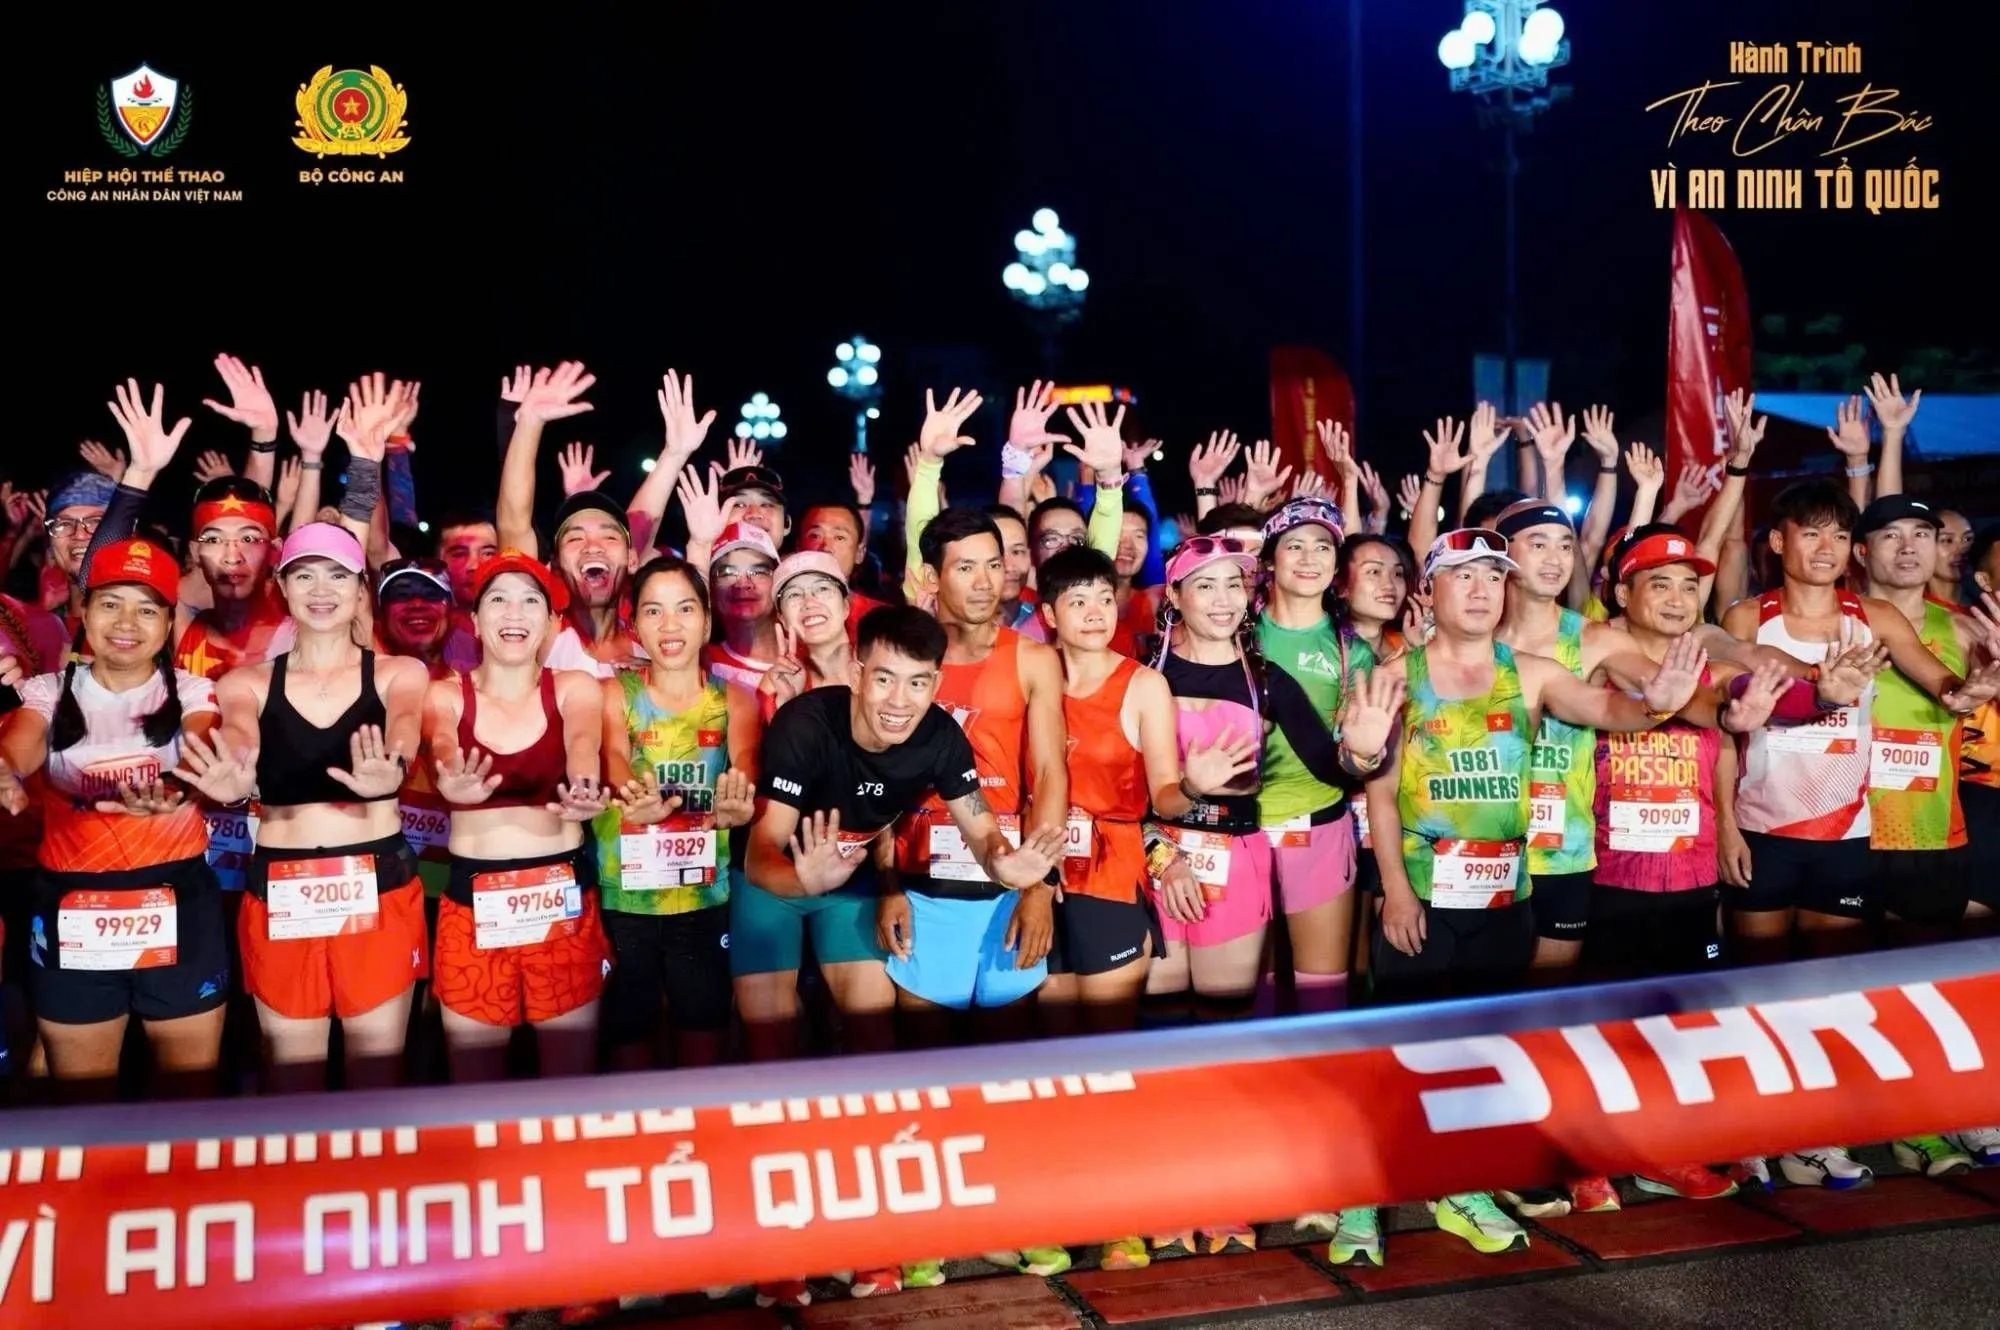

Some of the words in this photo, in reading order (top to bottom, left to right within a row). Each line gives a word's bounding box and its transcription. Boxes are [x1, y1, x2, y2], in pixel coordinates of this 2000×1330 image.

[1626, 731, 1680, 757] YEARS
[1681, 734, 1700, 758] OF
[1449, 749, 1499, 773] 1981
[1881, 747, 1929, 767] 90010
[656, 762, 706, 785] 1981
[1609, 755, 1699, 787] PASSION
[772, 776, 802, 797] RUN
[1429, 775, 1520, 801] RUNNERS
[1639, 808, 1691, 825] 90909
[1464, 862, 1511, 880] 99909
[299, 880, 365, 905] 92002
[507, 888, 564, 915] 99766
[95, 914, 162, 937] 99929
[106, 1202, 255, 1296] AN
[303, 1175, 545, 1277] NINH
[585, 1140, 715, 1244] TỔ
[750, 1122, 997, 1230] QUỐC
